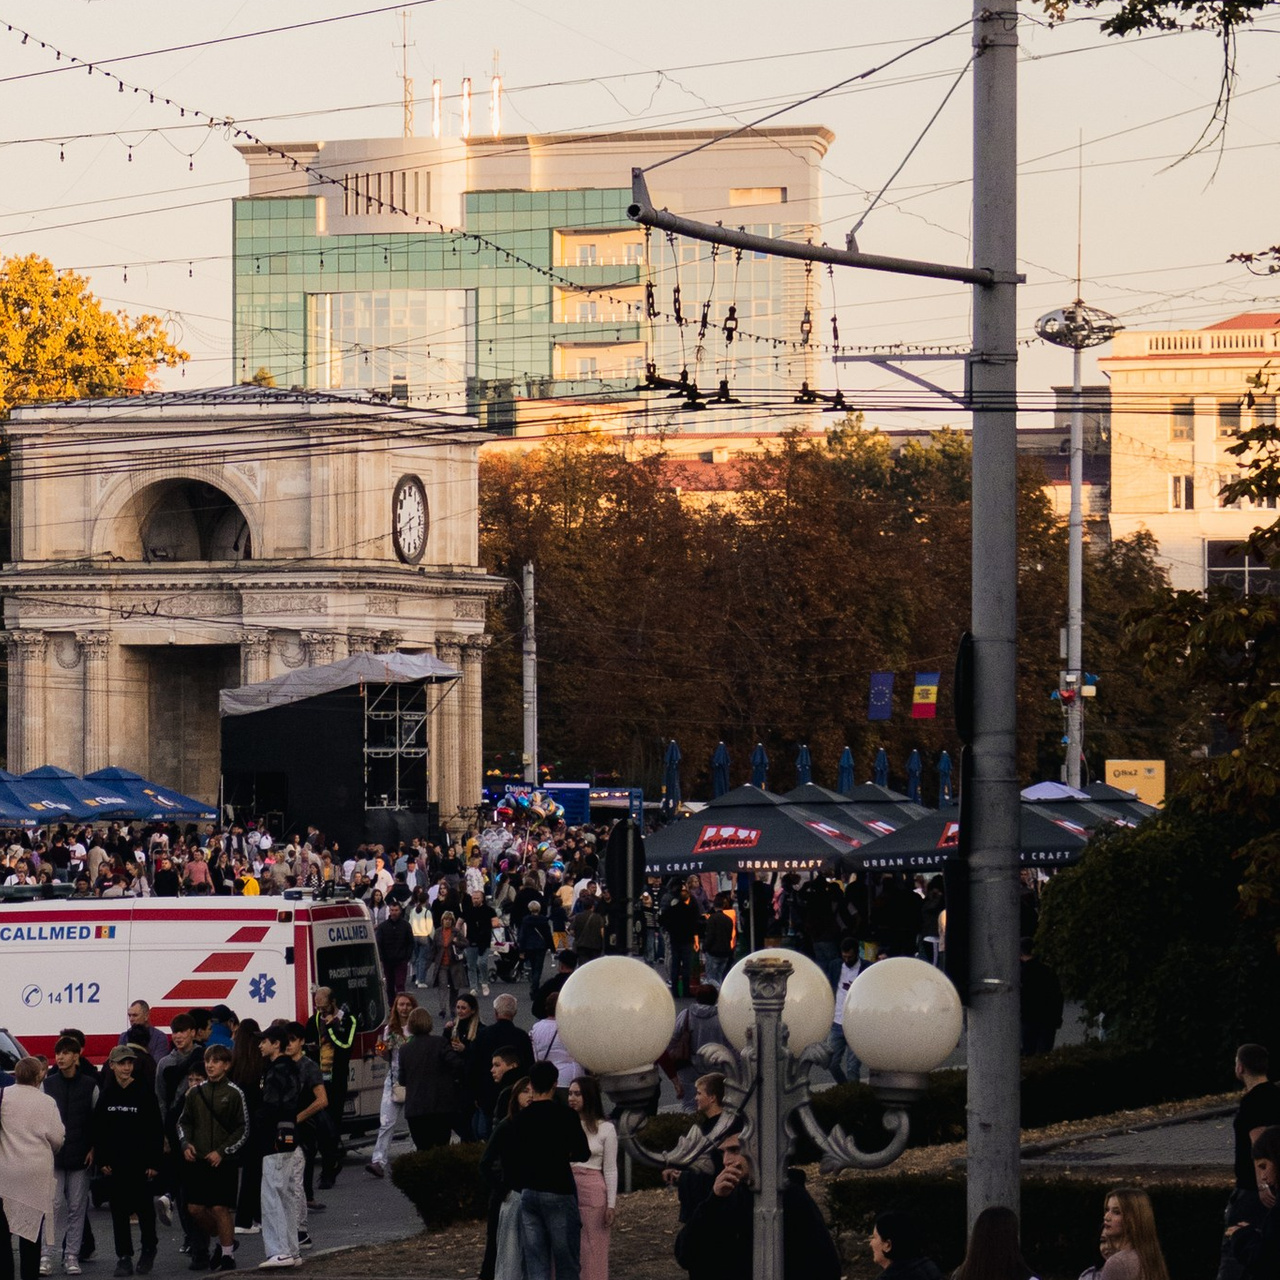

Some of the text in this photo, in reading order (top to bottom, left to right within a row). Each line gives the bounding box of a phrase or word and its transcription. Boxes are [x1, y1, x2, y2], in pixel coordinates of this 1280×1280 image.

[1031, 852, 1070, 860] CRAFT
[666, 862, 704, 872] CRAFT
[738, 860, 823, 868] URBAN CRAFT
[863, 858, 904, 868] URBAN
[0, 926, 91, 941] CALLMED
[328, 925, 368, 942] CALLMED
[48, 982, 100, 1004] 14 112
